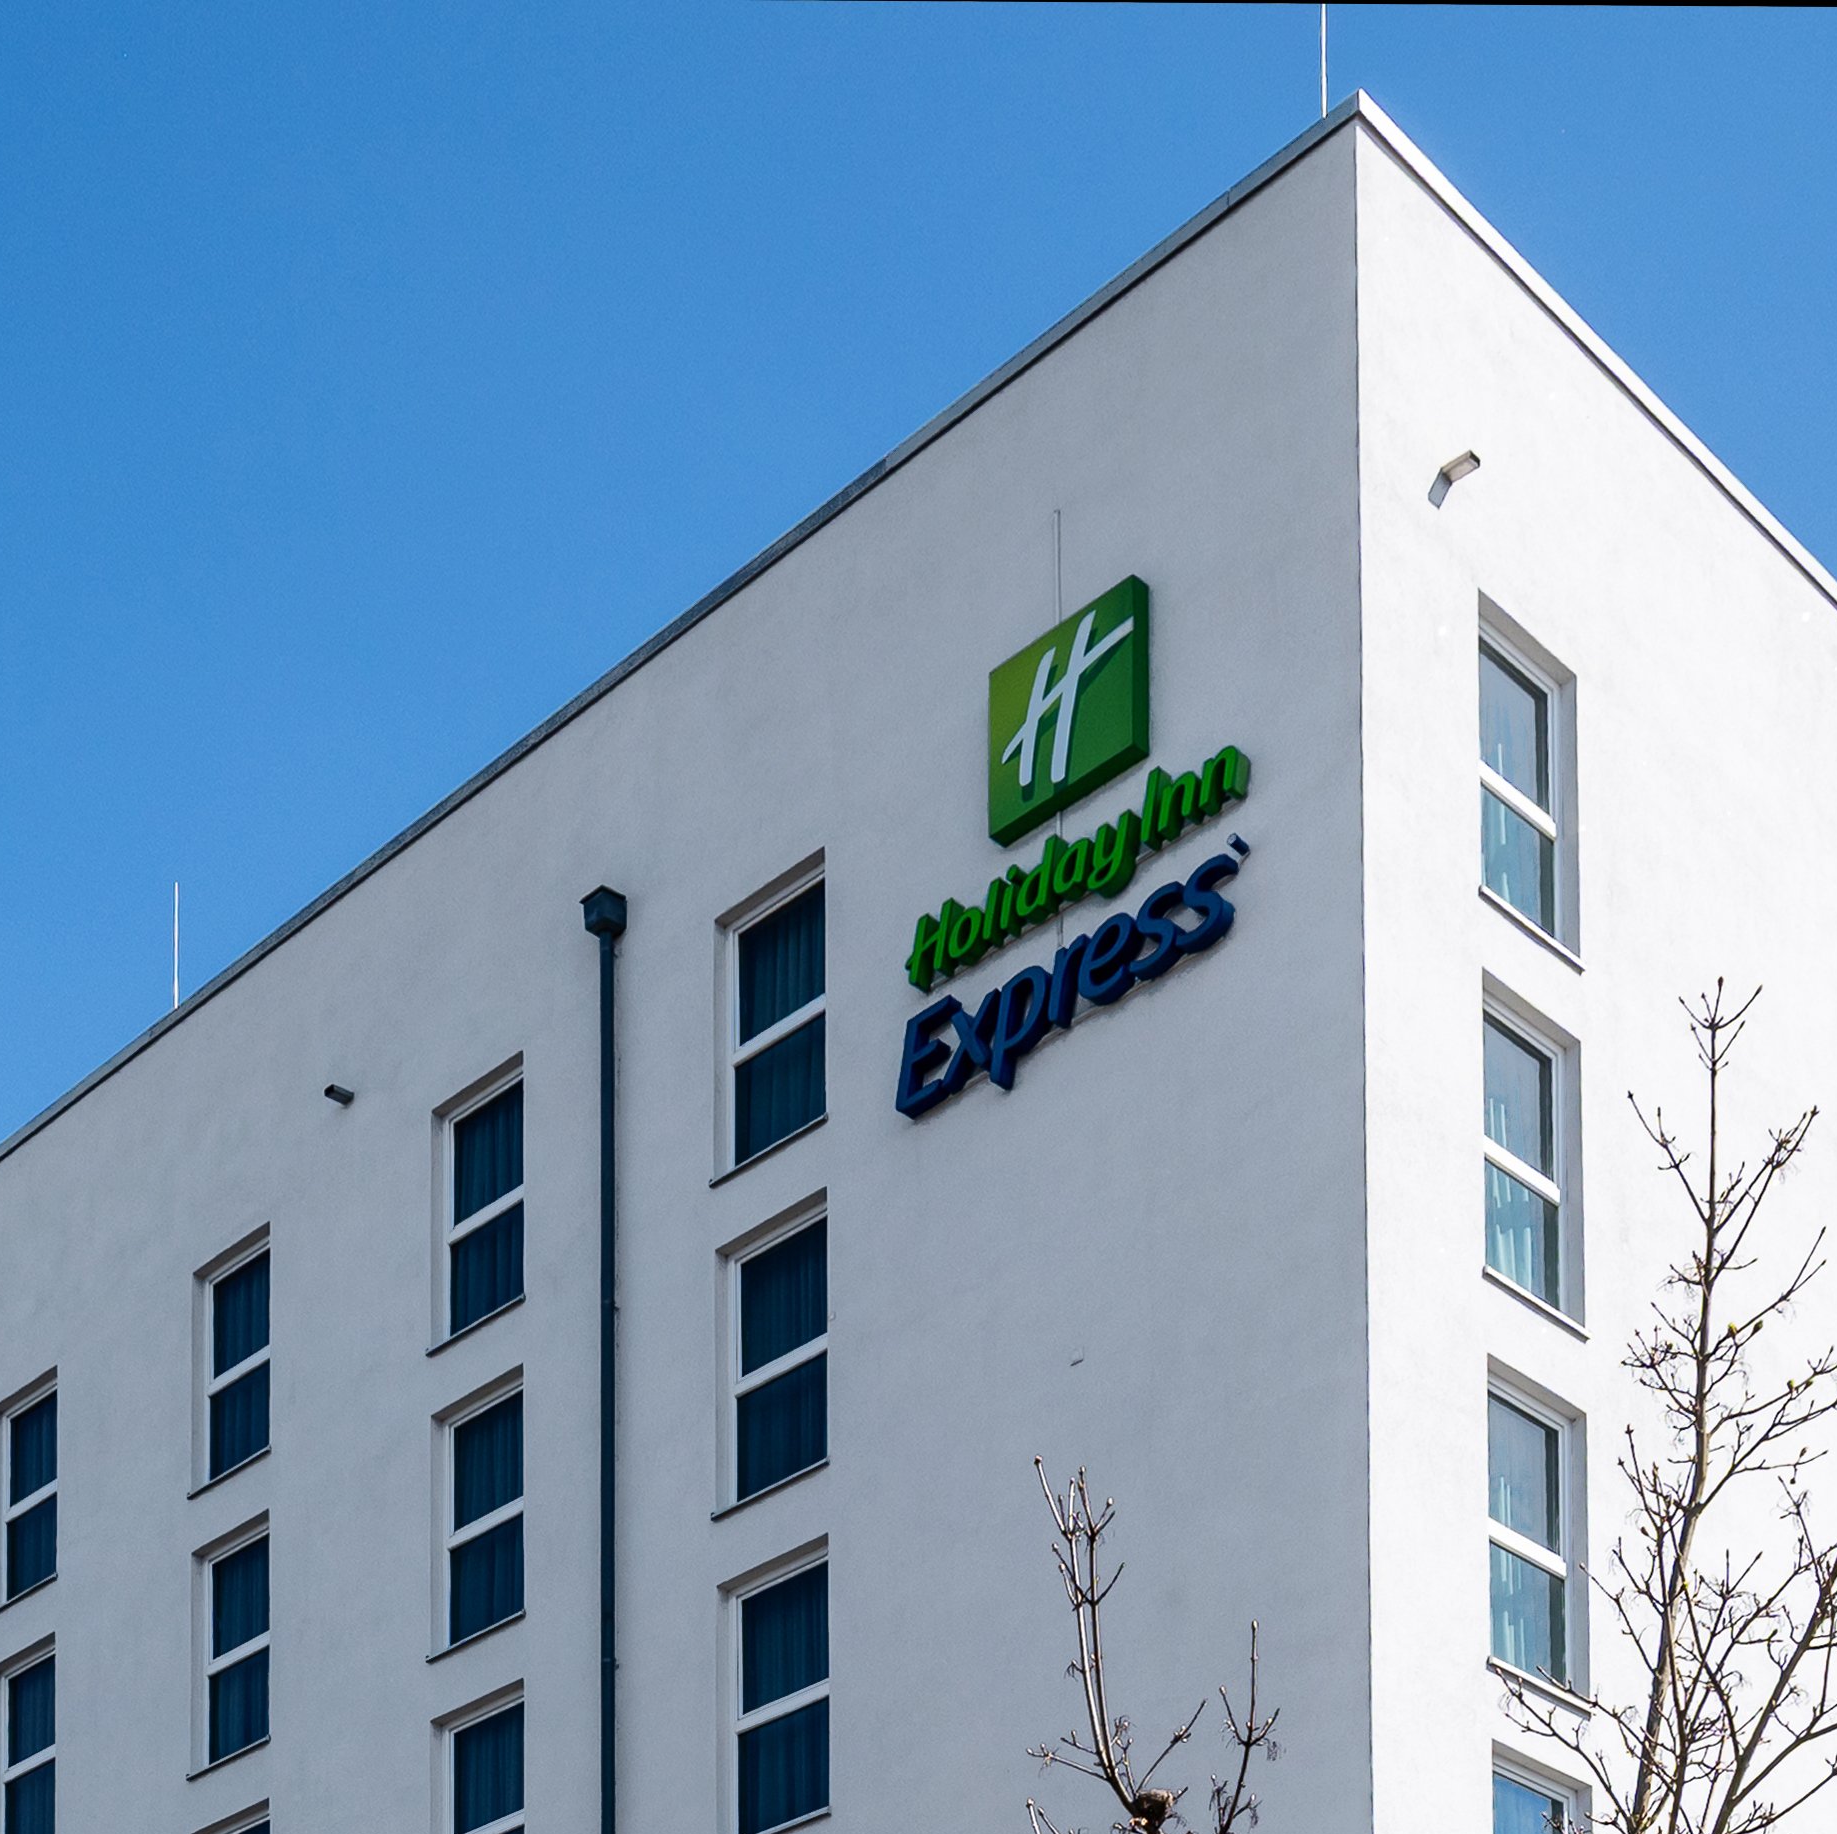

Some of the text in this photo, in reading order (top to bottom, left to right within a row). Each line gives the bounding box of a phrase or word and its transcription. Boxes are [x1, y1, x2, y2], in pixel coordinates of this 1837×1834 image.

[895, 851, 1241, 1120] Express
[905, 745, 1251, 993] Holiday Inn
